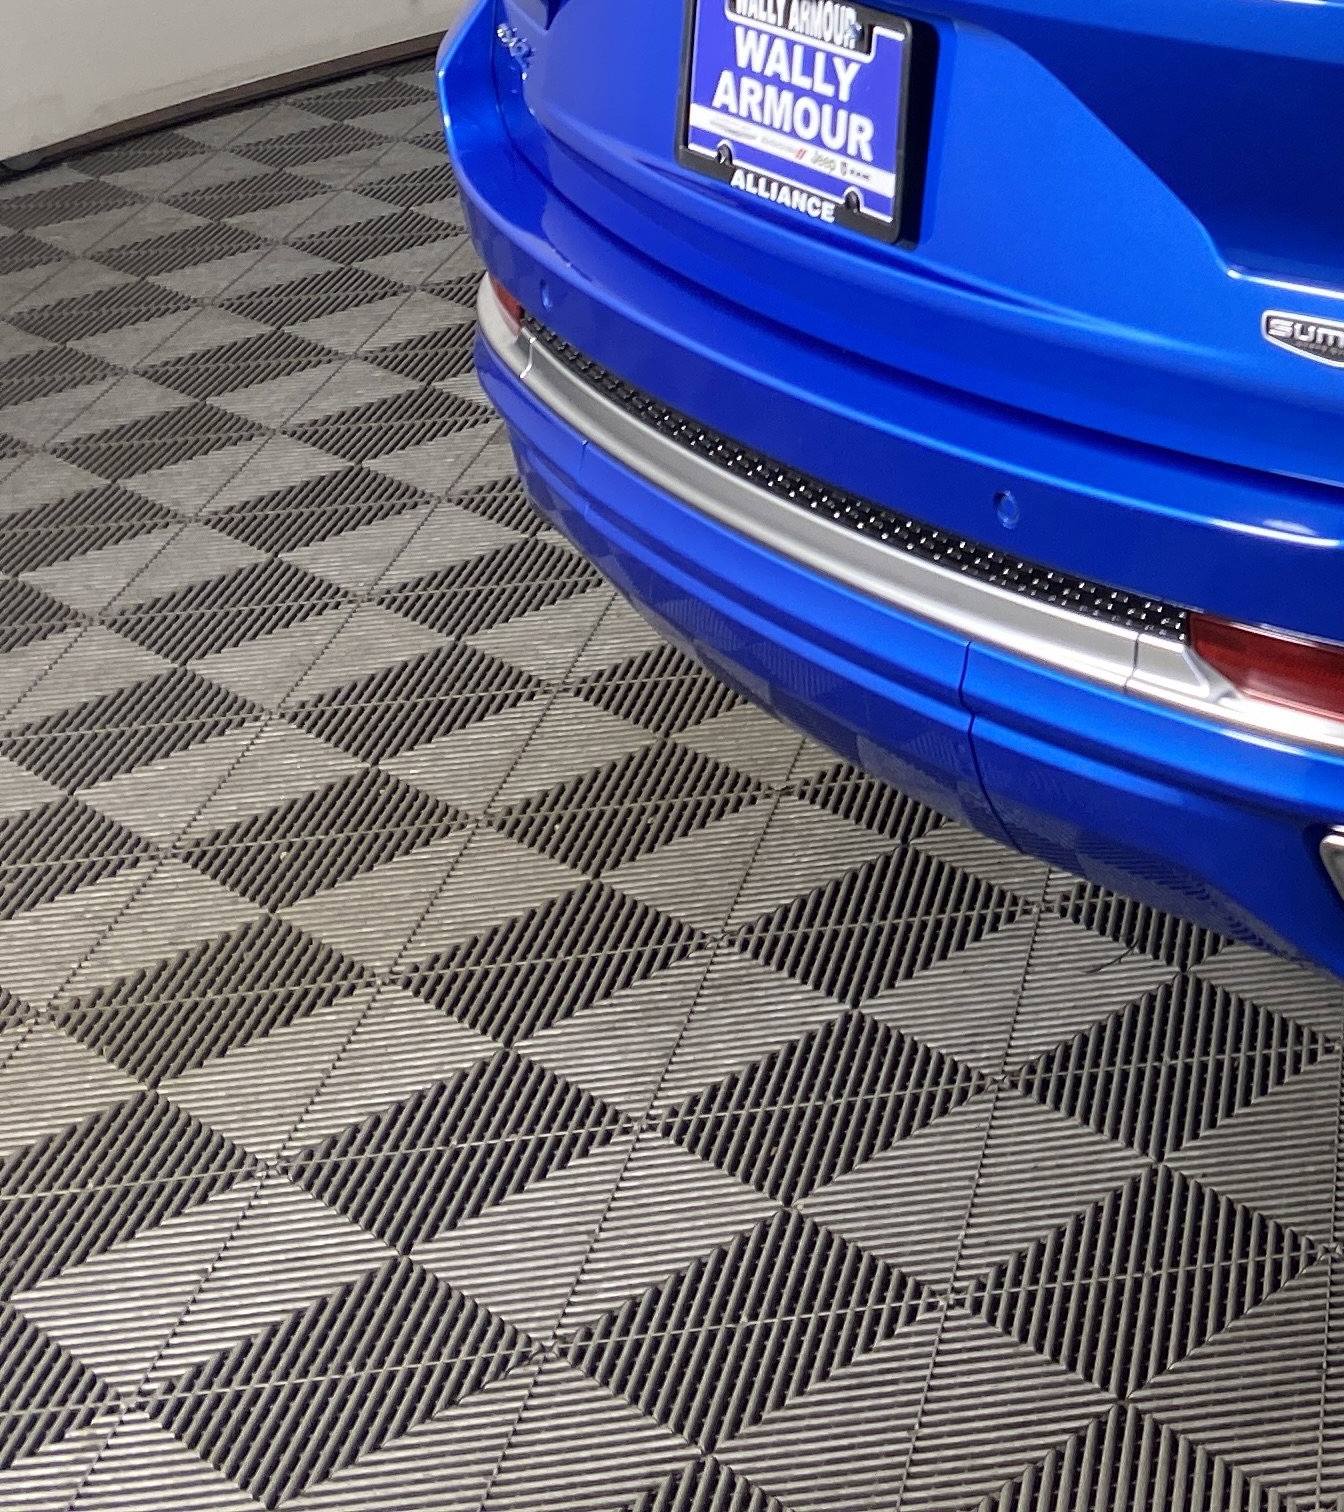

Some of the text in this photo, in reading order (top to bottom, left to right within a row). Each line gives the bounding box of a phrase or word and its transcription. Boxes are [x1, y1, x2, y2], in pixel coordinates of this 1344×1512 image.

[735, 25, 862, 103] WALLY
[711, 69, 875, 162] ARMOUR
[730, 169, 836, 224] ALLIANCE
